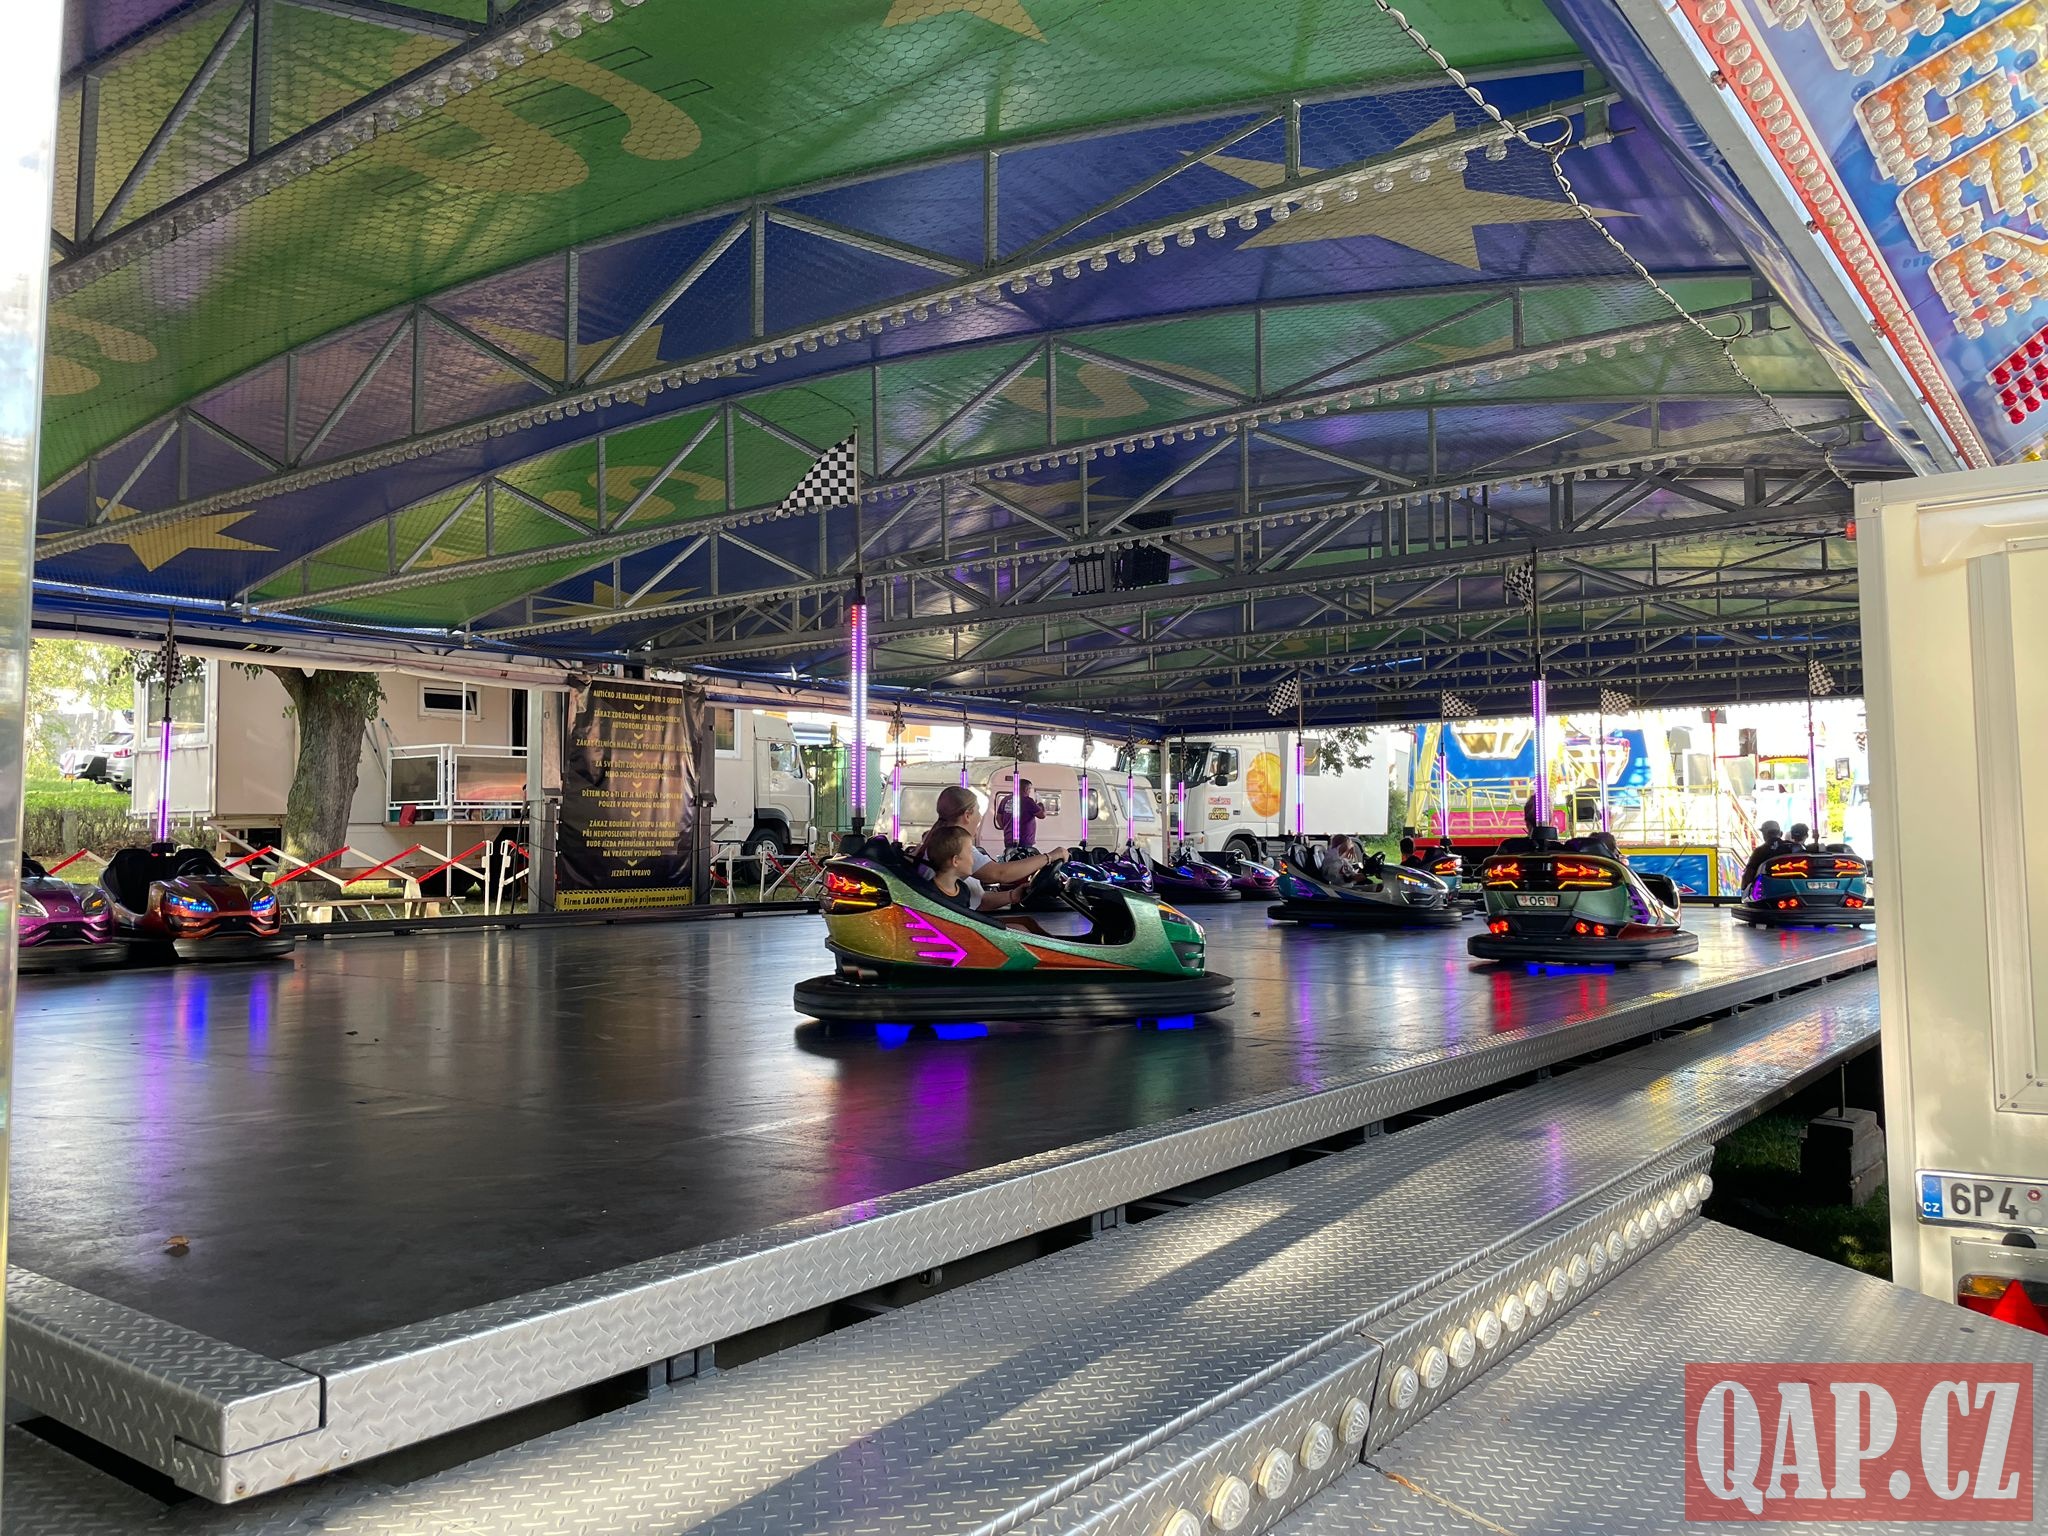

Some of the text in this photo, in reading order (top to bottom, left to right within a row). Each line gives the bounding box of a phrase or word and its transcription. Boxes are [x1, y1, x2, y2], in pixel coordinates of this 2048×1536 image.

[615, 691, 622, 699] JE
[667, 697, 682, 705] OSOBY
[594, 709, 611, 717] ZÁKAZ
[647, 714, 655, 722] NA
[582, 788, 600, 797] DĚTEM
[601, 790, 610, 798] DO
[589, 819, 608, 828] ZÁKAZ
[582, 829, 593, 837] PŘI
[611, 869, 651, 877] JEZDĚTE VPRAVO
[564, 897, 581, 905] Firma
[582, 896, 610, 905] LAGRON
[1530, 896, 1546, 906] 06
[1949, 1182, 2019, 1220] 6P4
[1923, 1201, 1940, 1213] CZ
